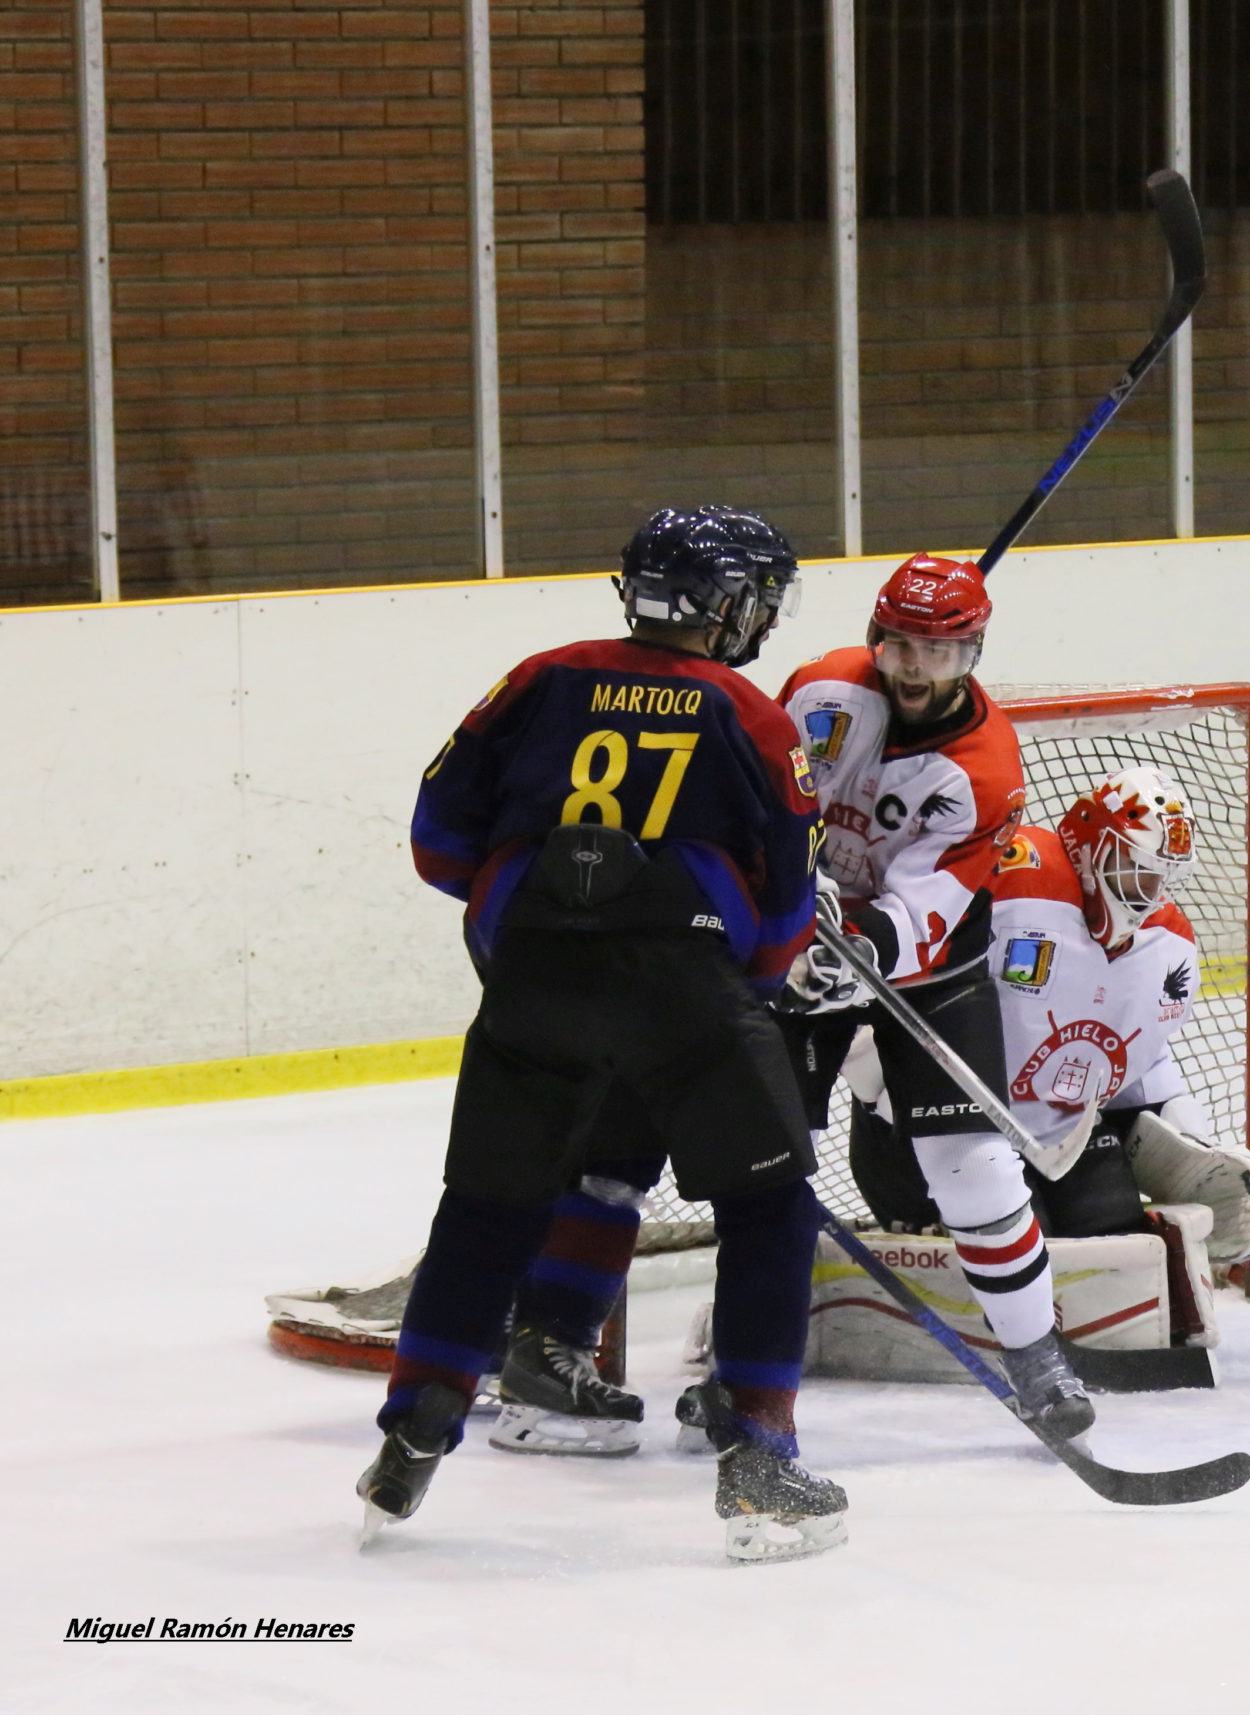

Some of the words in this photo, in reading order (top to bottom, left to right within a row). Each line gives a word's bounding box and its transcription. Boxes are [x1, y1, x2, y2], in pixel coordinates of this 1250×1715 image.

[909, 579, 937, 596] 22
[591, 683, 702, 716] MARTOCQ
[560, 729, 700, 840] 87
[875, 794, 907, 831] C
[1011, 1045, 1052, 1094] CLUB
[1060, 1024, 1118, 1051] HIELO
[912, 1103, 983, 1118] EASTO
[751, 1151, 790, 1171] BAUER
